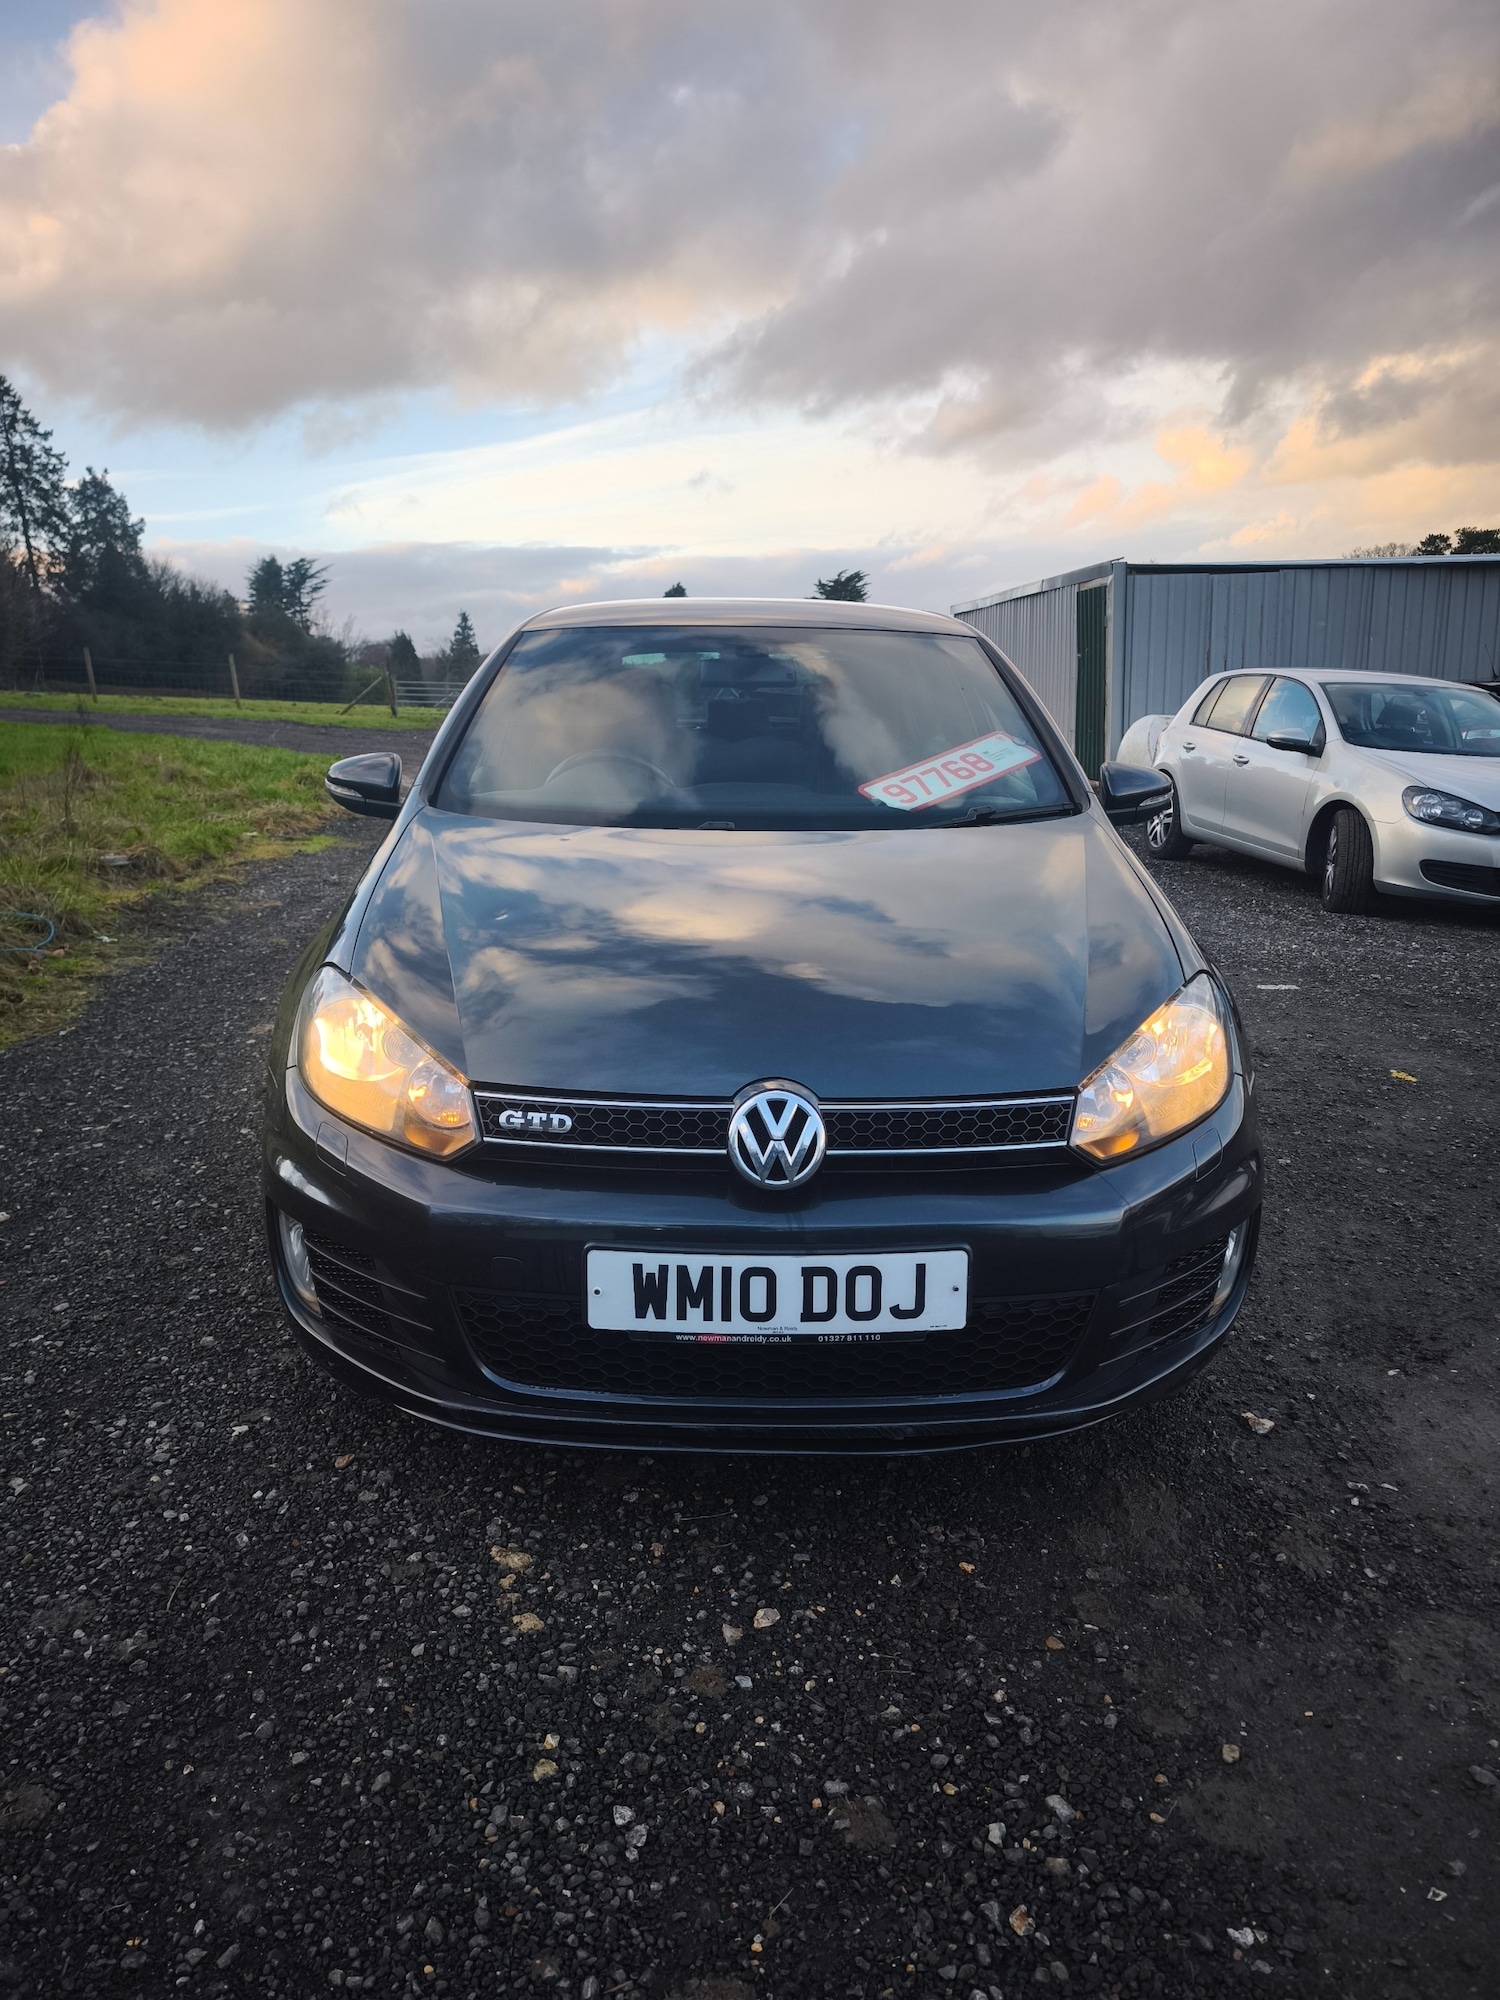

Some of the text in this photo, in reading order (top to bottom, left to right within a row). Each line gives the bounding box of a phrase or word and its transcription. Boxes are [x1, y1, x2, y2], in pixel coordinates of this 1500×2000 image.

[882, 753, 995, 804] 97768
[498, 1109, 573, 1134] GTD
[632, 1263, 927, 1323] WM10 DOJ
[675, 1334, 792, 1343] www.newmanandreidy.co.uk
